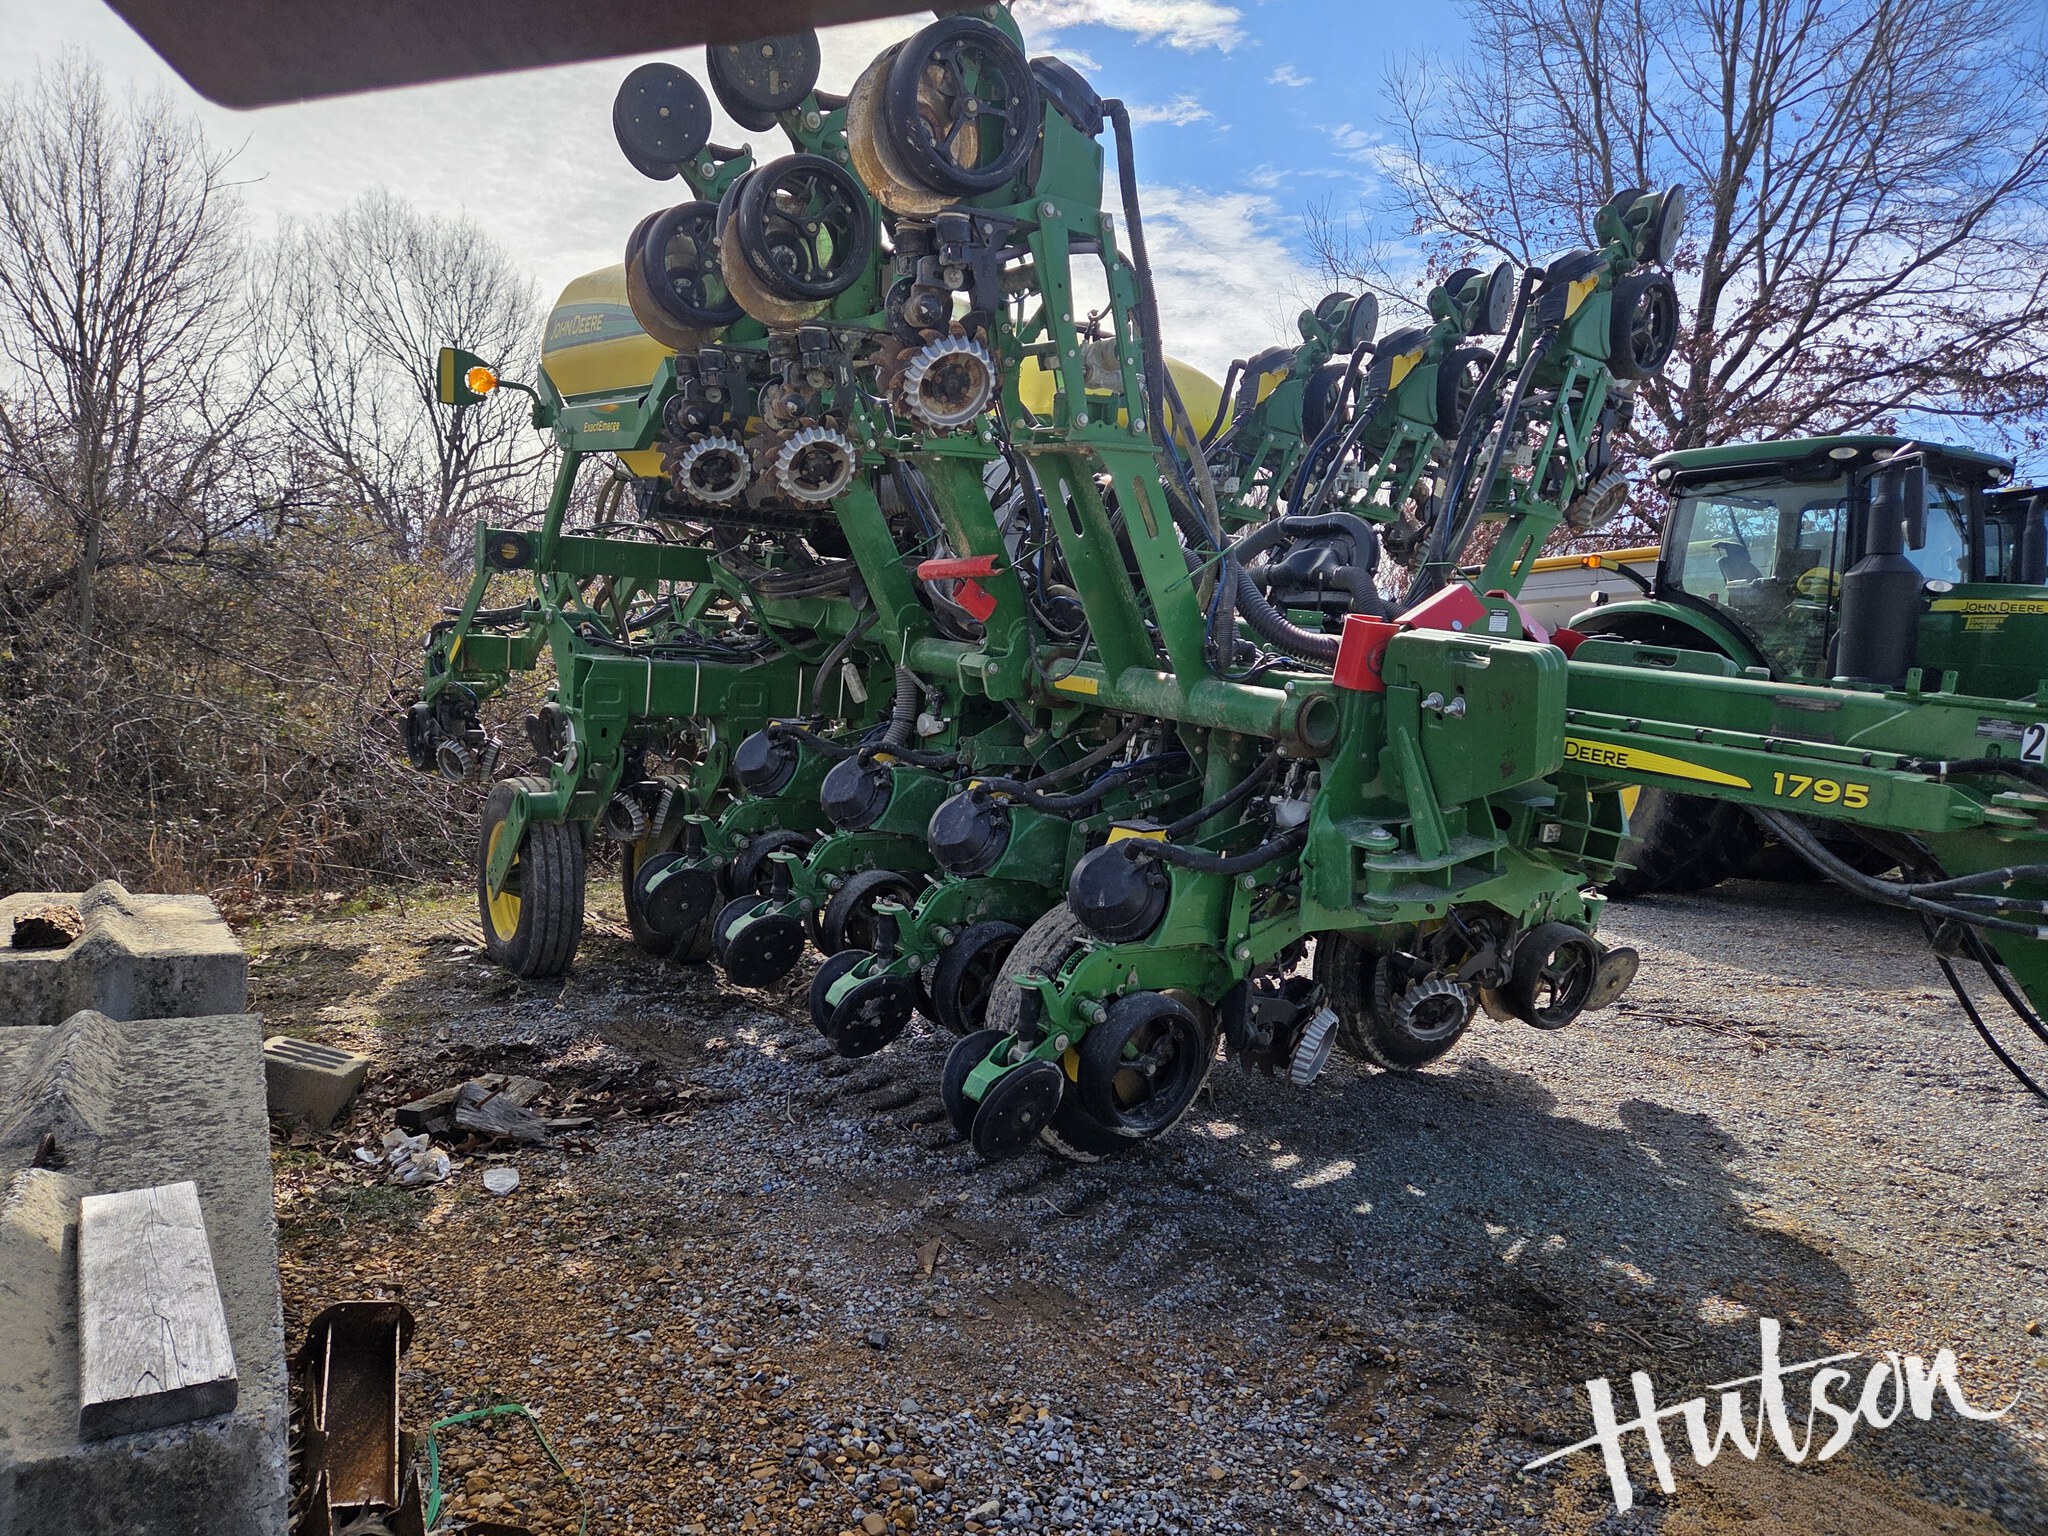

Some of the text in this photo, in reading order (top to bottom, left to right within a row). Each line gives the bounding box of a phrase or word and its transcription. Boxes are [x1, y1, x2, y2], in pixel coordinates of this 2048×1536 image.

[551, 313, 605, 340] JOHN DEERE
[583, 420, 620, 433] ExactEmerge
[1961, 602, 2044, 613] JOHN DEERE
[1564, 741, 1629, 766] DEERE
[2023, 724, 2045, 761] 2
[1772, 771, 1870, 809] 1795
